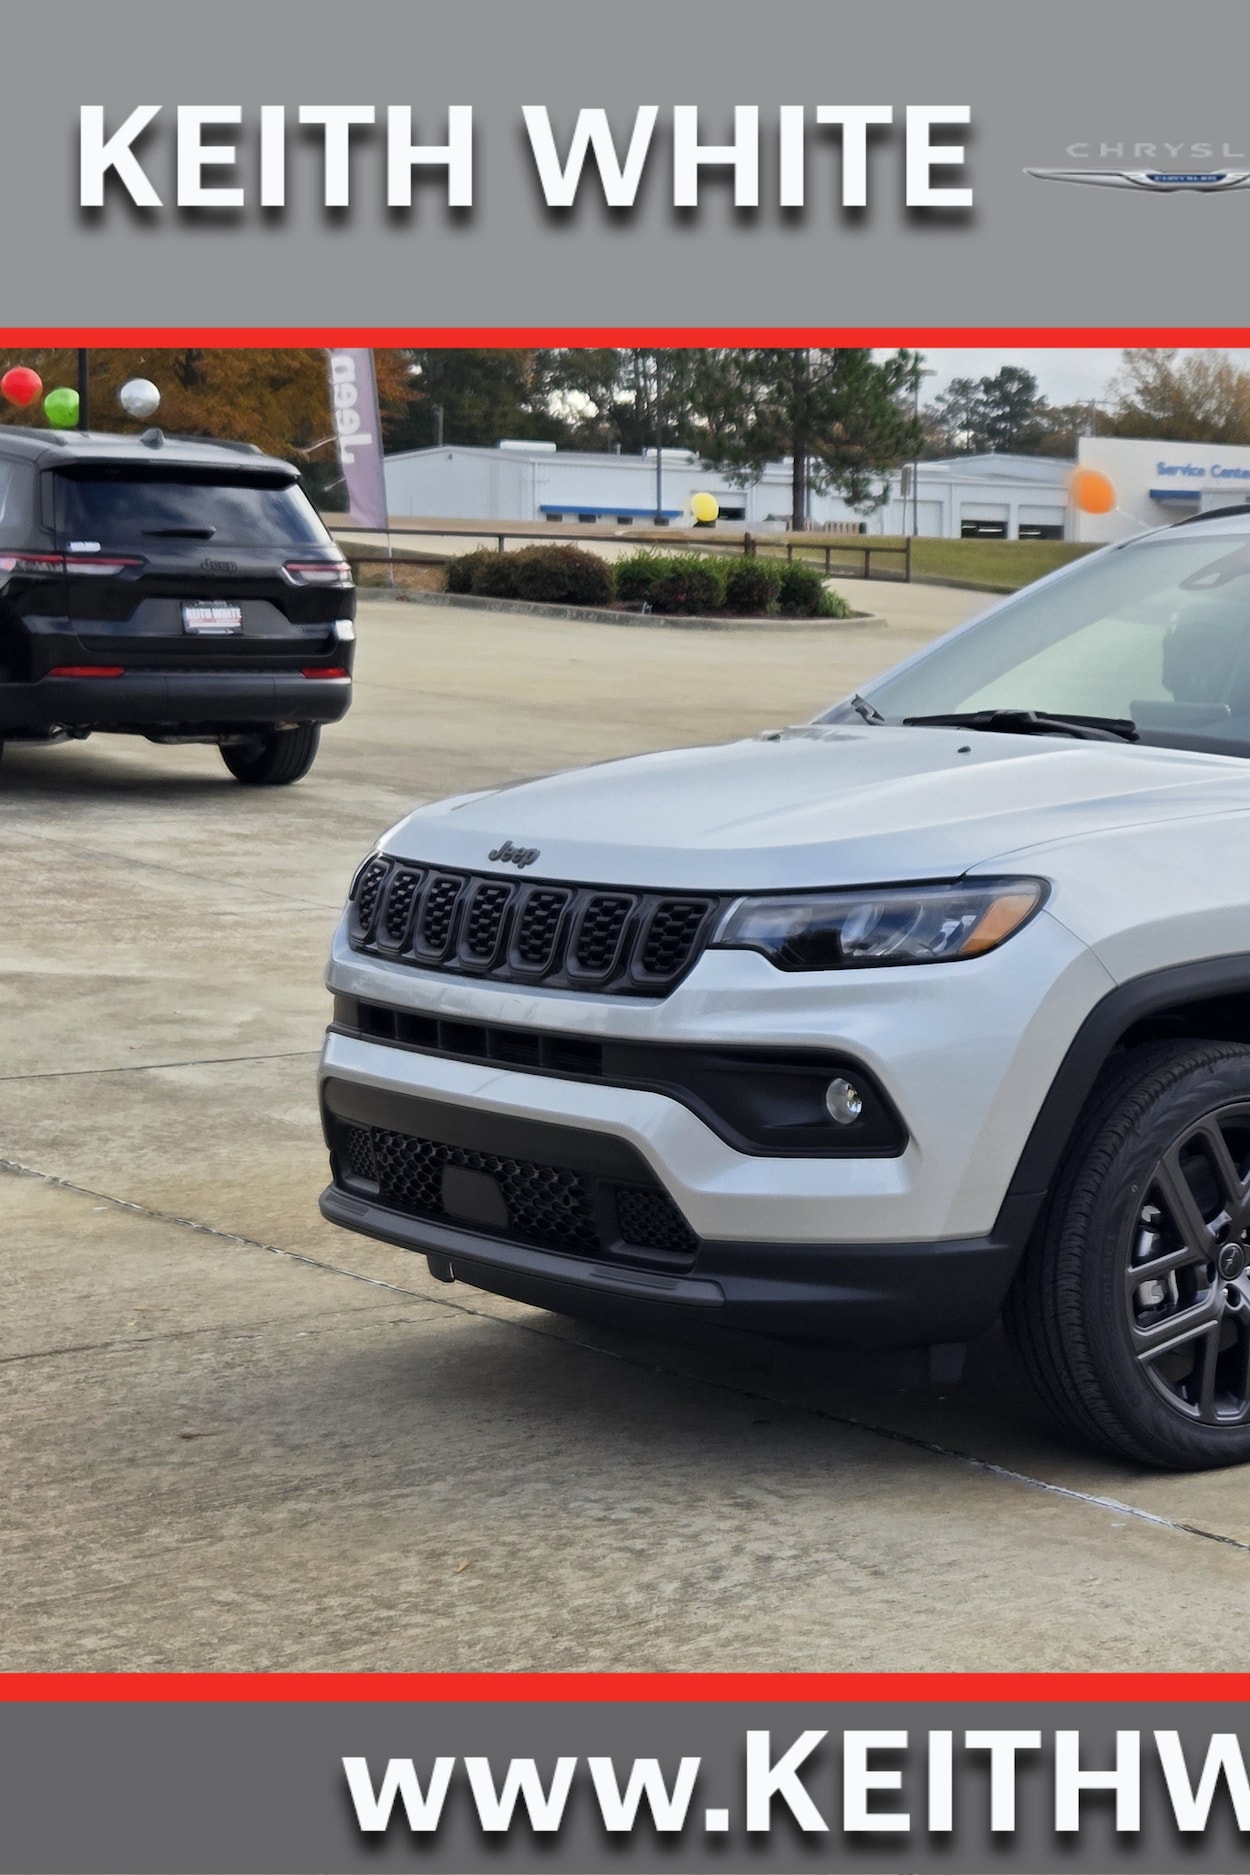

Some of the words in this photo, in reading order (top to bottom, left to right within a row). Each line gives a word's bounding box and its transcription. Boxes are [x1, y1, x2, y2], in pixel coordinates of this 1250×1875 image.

[1156, 461, 1206, 477] Service
[201, 558, 238, 573] Jeep
[488, 840, 541, 869] Jeep
